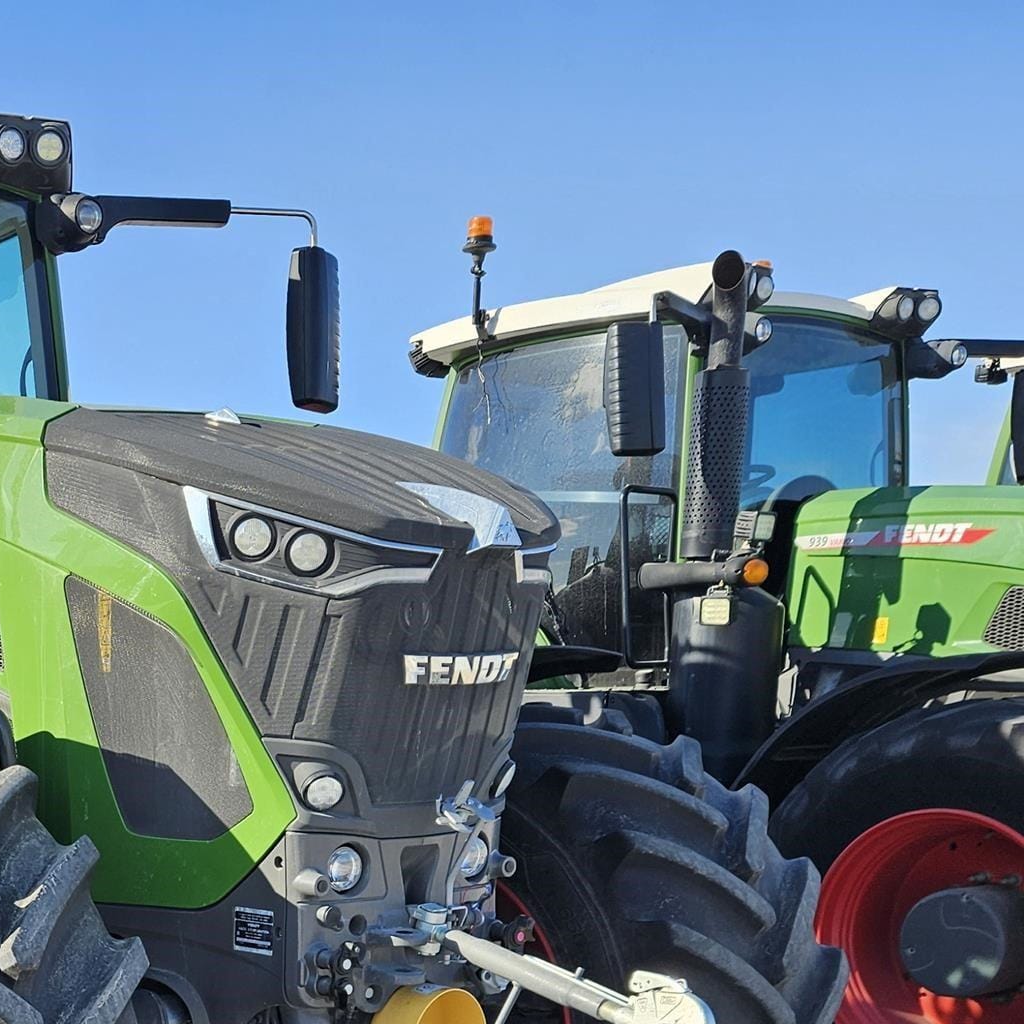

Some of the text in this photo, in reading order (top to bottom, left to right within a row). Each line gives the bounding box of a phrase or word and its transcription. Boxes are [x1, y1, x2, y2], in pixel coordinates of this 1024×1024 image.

[808, 536, 828, 547] 939
[884, 523, 973, 544] FENDT
[403, 652, 519, 685] FENDT
